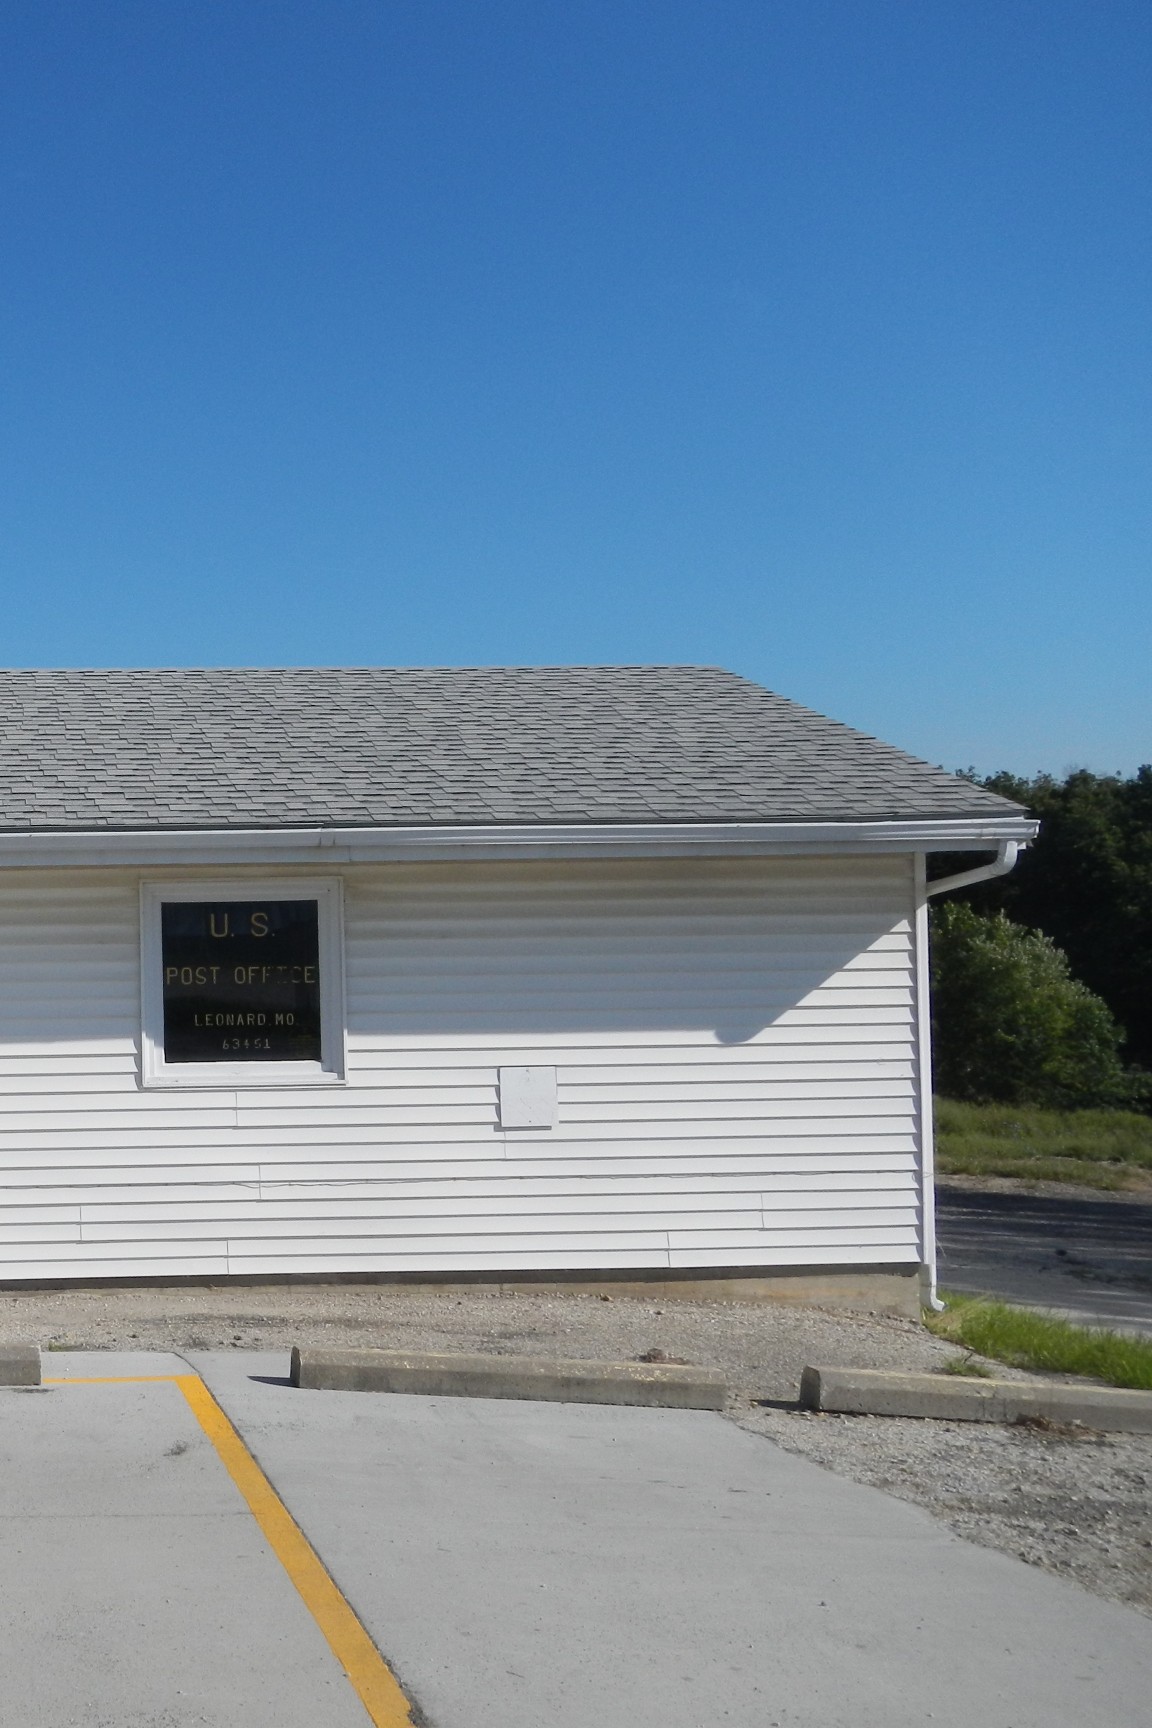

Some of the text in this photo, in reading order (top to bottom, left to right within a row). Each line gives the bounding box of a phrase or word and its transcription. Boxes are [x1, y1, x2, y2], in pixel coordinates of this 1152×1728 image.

[210, 912, 276, 938] U. S.
[166, 966, 221, 985] POST
[222, 1038, 271, 1050] 63451
